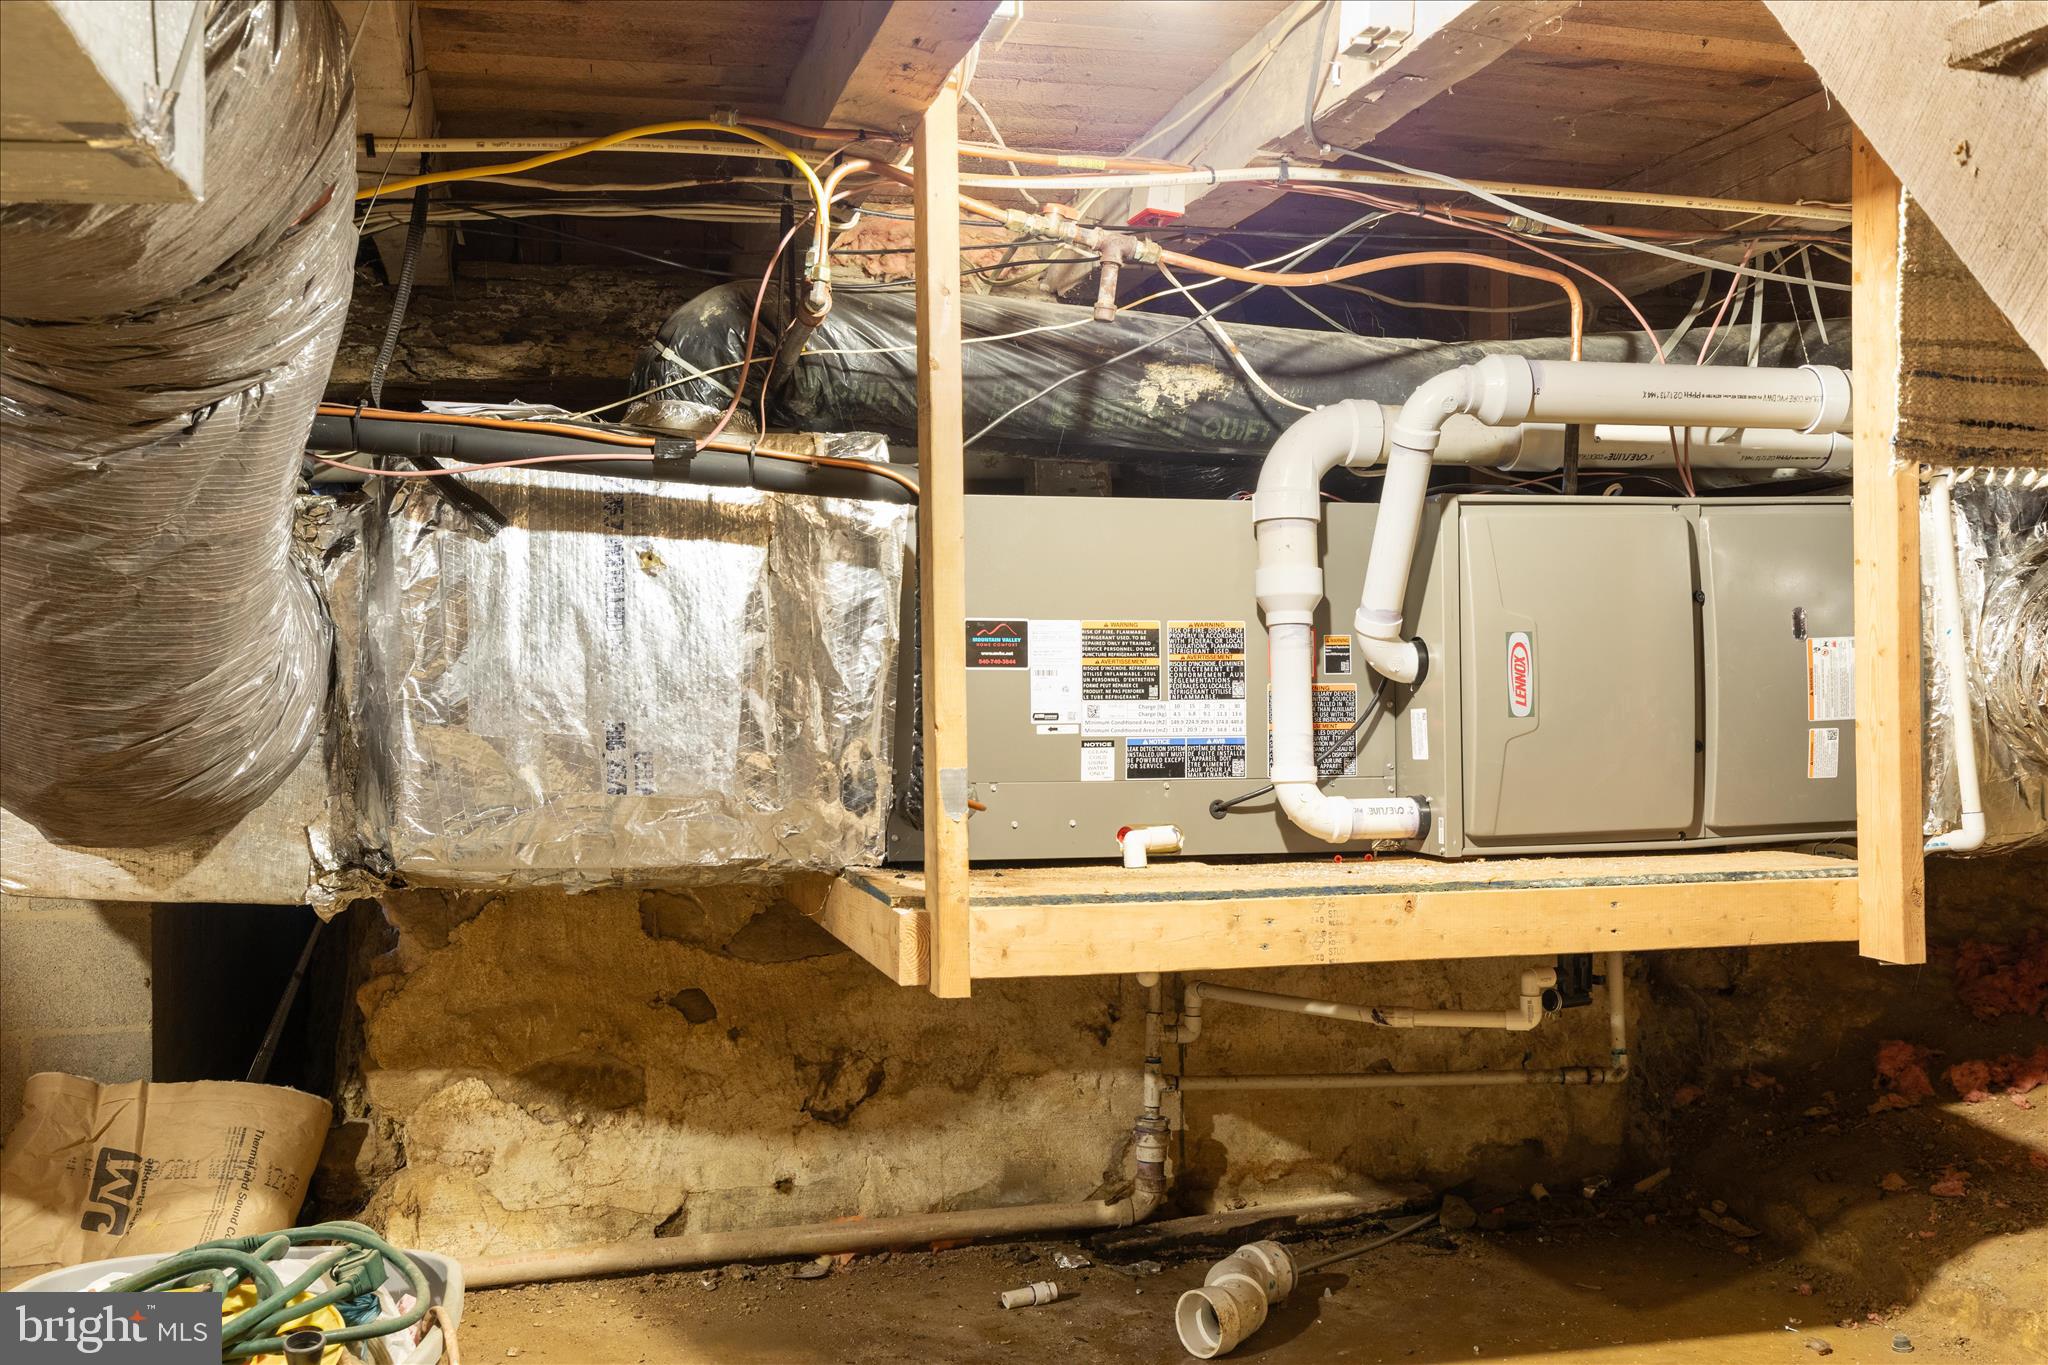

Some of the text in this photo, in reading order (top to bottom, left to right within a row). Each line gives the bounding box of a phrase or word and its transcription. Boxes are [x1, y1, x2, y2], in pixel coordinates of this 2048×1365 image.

[1514, 655, 1527, 706] LENNOX
[246, 1129, 265, 1170] Thermal
[241, 1171, 254, 1191] and
[230, 1191, 248, 1226] Sound
